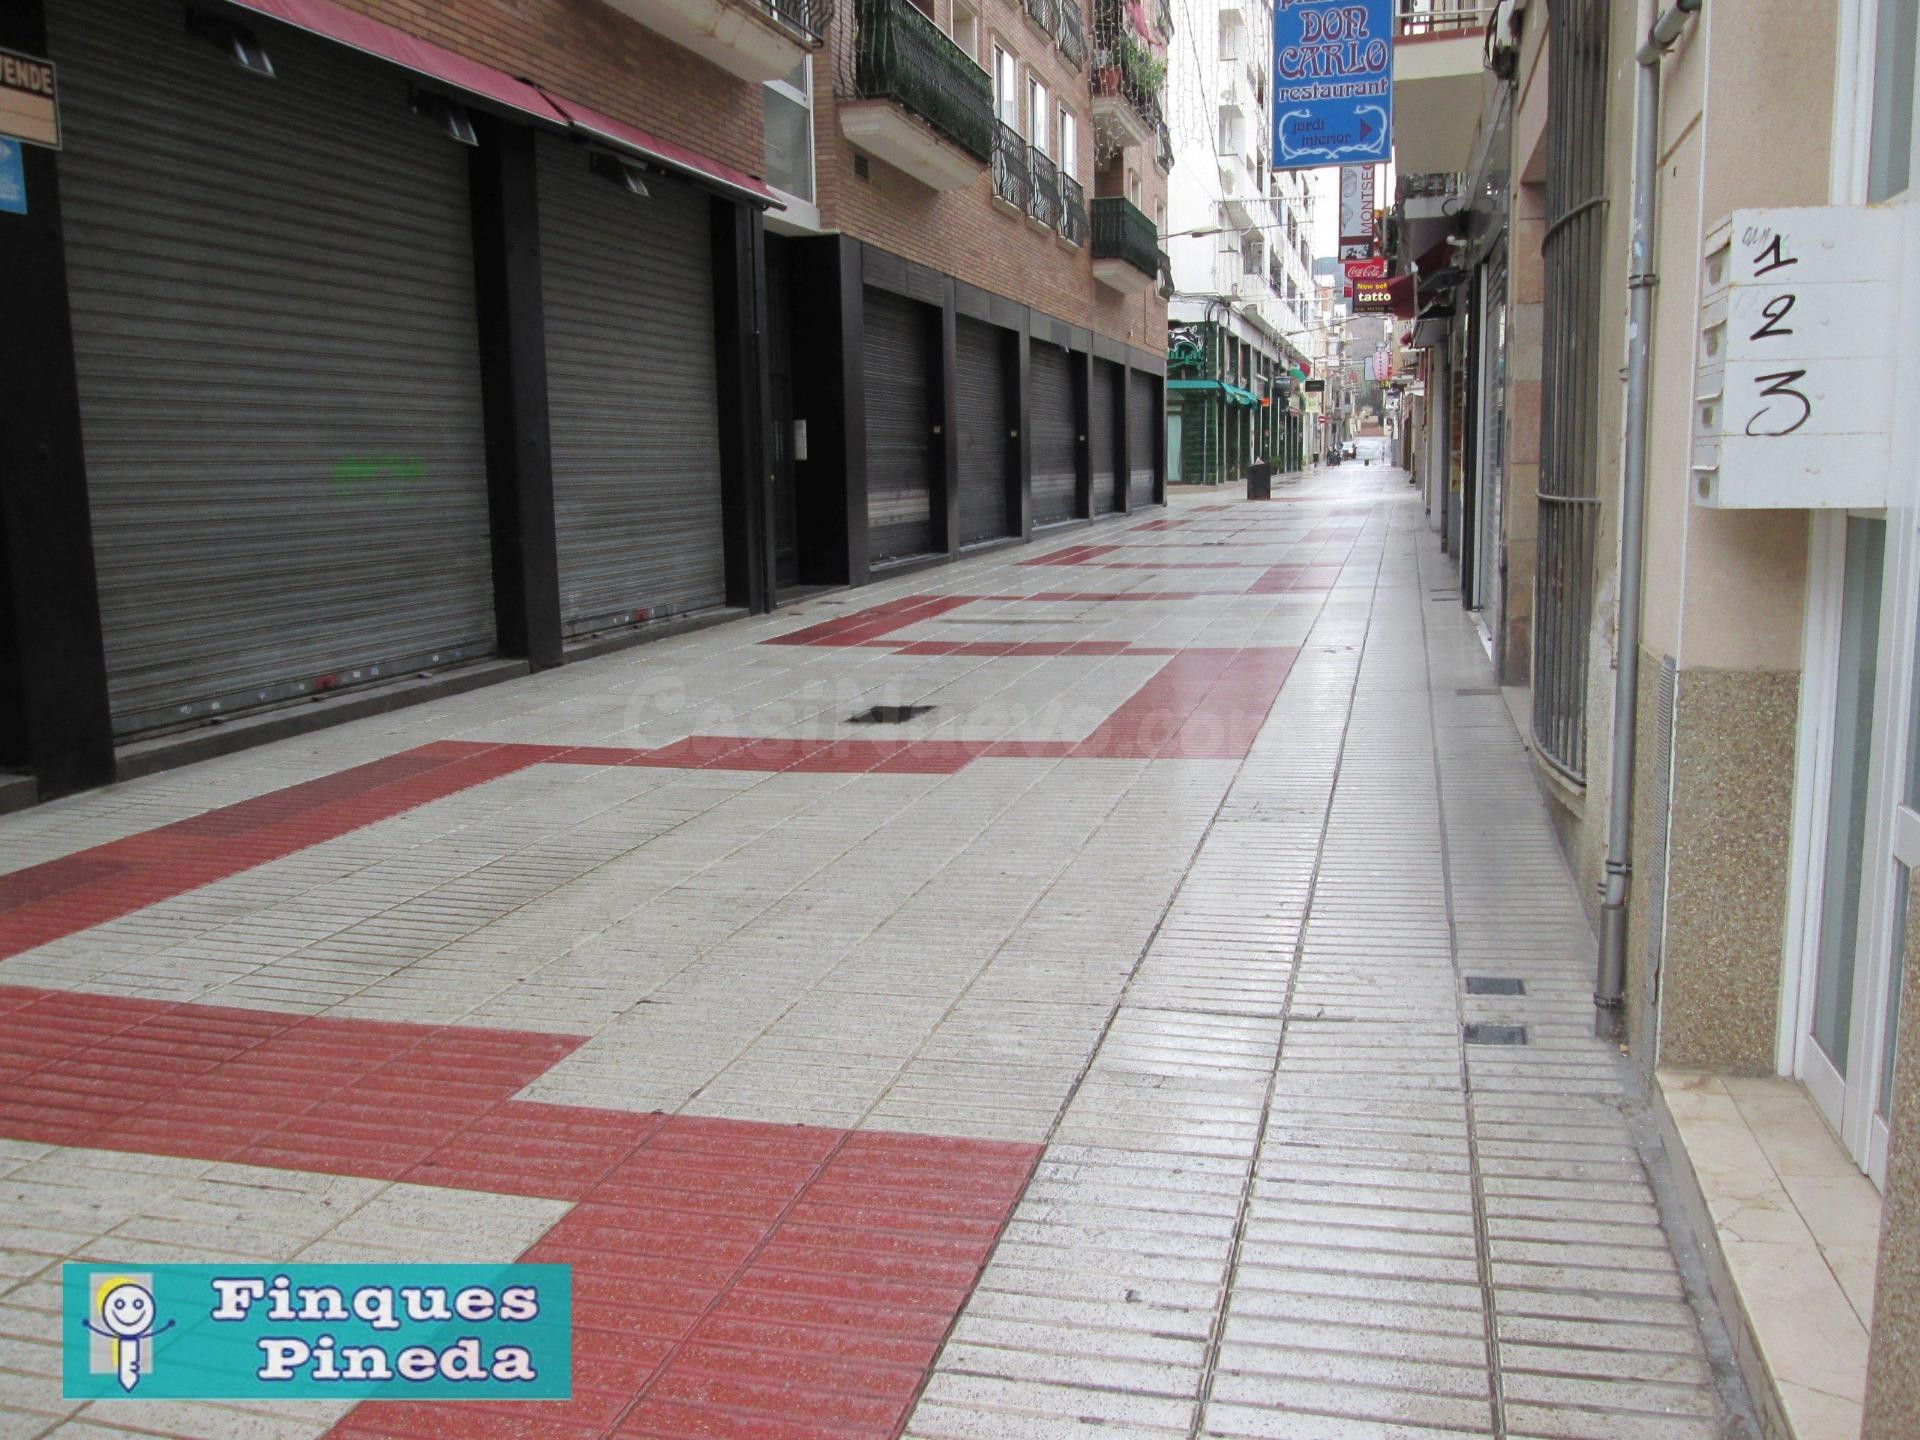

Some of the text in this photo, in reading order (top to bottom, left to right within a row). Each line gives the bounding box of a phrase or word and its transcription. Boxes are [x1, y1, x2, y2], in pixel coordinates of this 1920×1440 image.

[1300, 6, 1369, 43] DON
[1279, 40, 1387, 80] CARLO
[1279, 77, 1388, 101] restaurant
[1302, 131, 1350, 146] interior
[1753, 234, 1798, 278] 1
[1750, 294, 1796, 341] 2
[1746, 369, 1811, 437] 3
